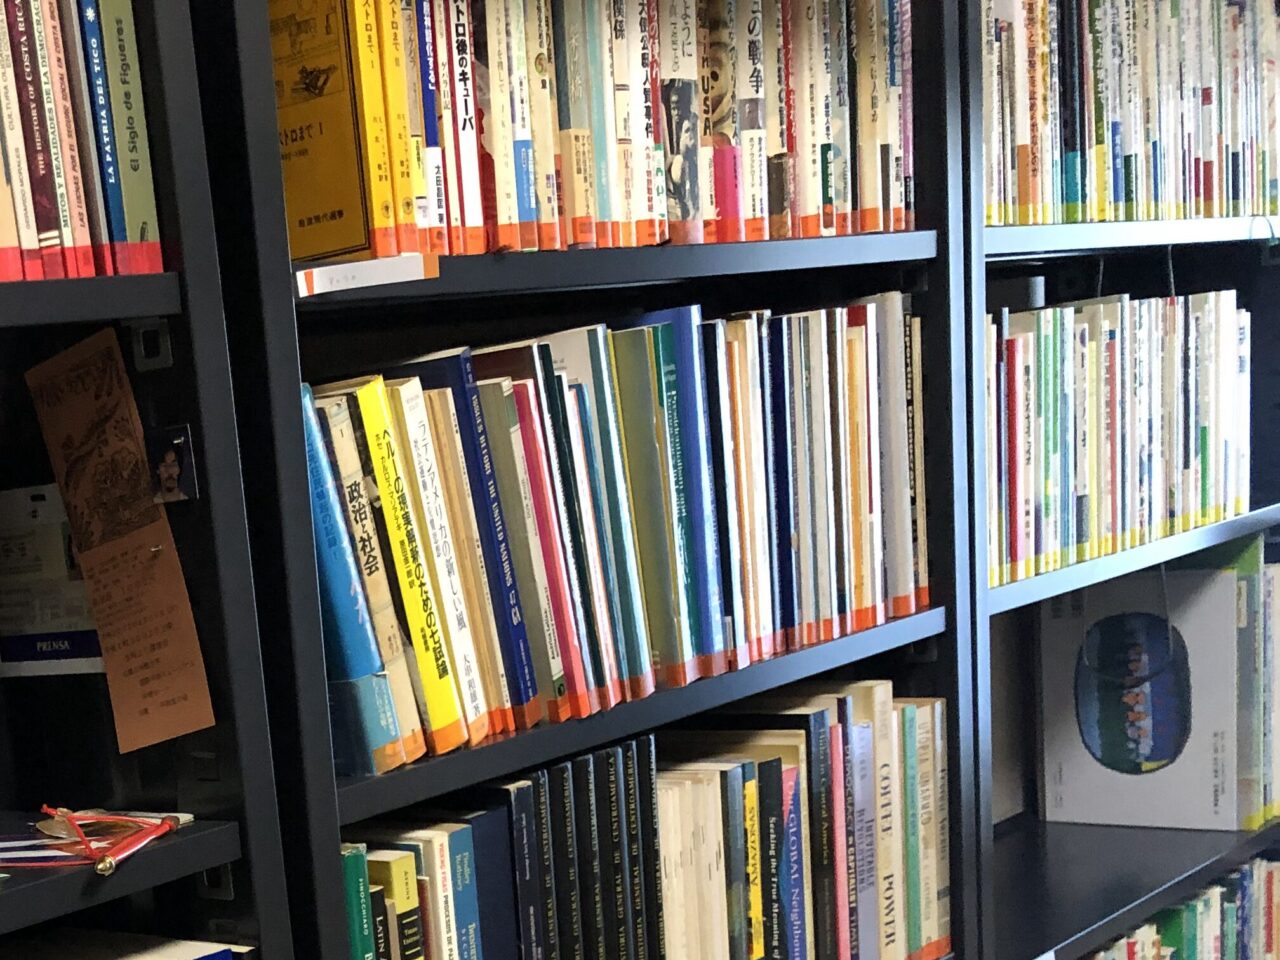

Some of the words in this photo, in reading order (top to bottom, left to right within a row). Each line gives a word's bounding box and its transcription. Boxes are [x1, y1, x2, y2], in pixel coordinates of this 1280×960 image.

[21, 38, 33, 82] COSTA
[90, 38, 102, 74] TICO
[115, 18, 131, 86] Figueres
[96, 78, 105, 105] DEL
[702, 76, 712, 137] USA
[30, 100, 44, 152] HISTORY
[46, 104, 62, 179] REALIDADES
[100, 110, 113, 163] PATRIA
[124, 115, 139, 154] Siglo
[58, 195, 70, 228] MITOS
[346, 480, 380, 576] 政治と社会
[492, 504, 505, 542] UNITED
[500, 547, 514, 587] NATIONS
[37, 640, 70, 651] PRENSA
[749, 806, 760, 886] AMAZONAS
[616, 873, 624, 919] GENERAL
[883, 873, 897, 948] POWER
[376, 916, 387, 943] LATIN
